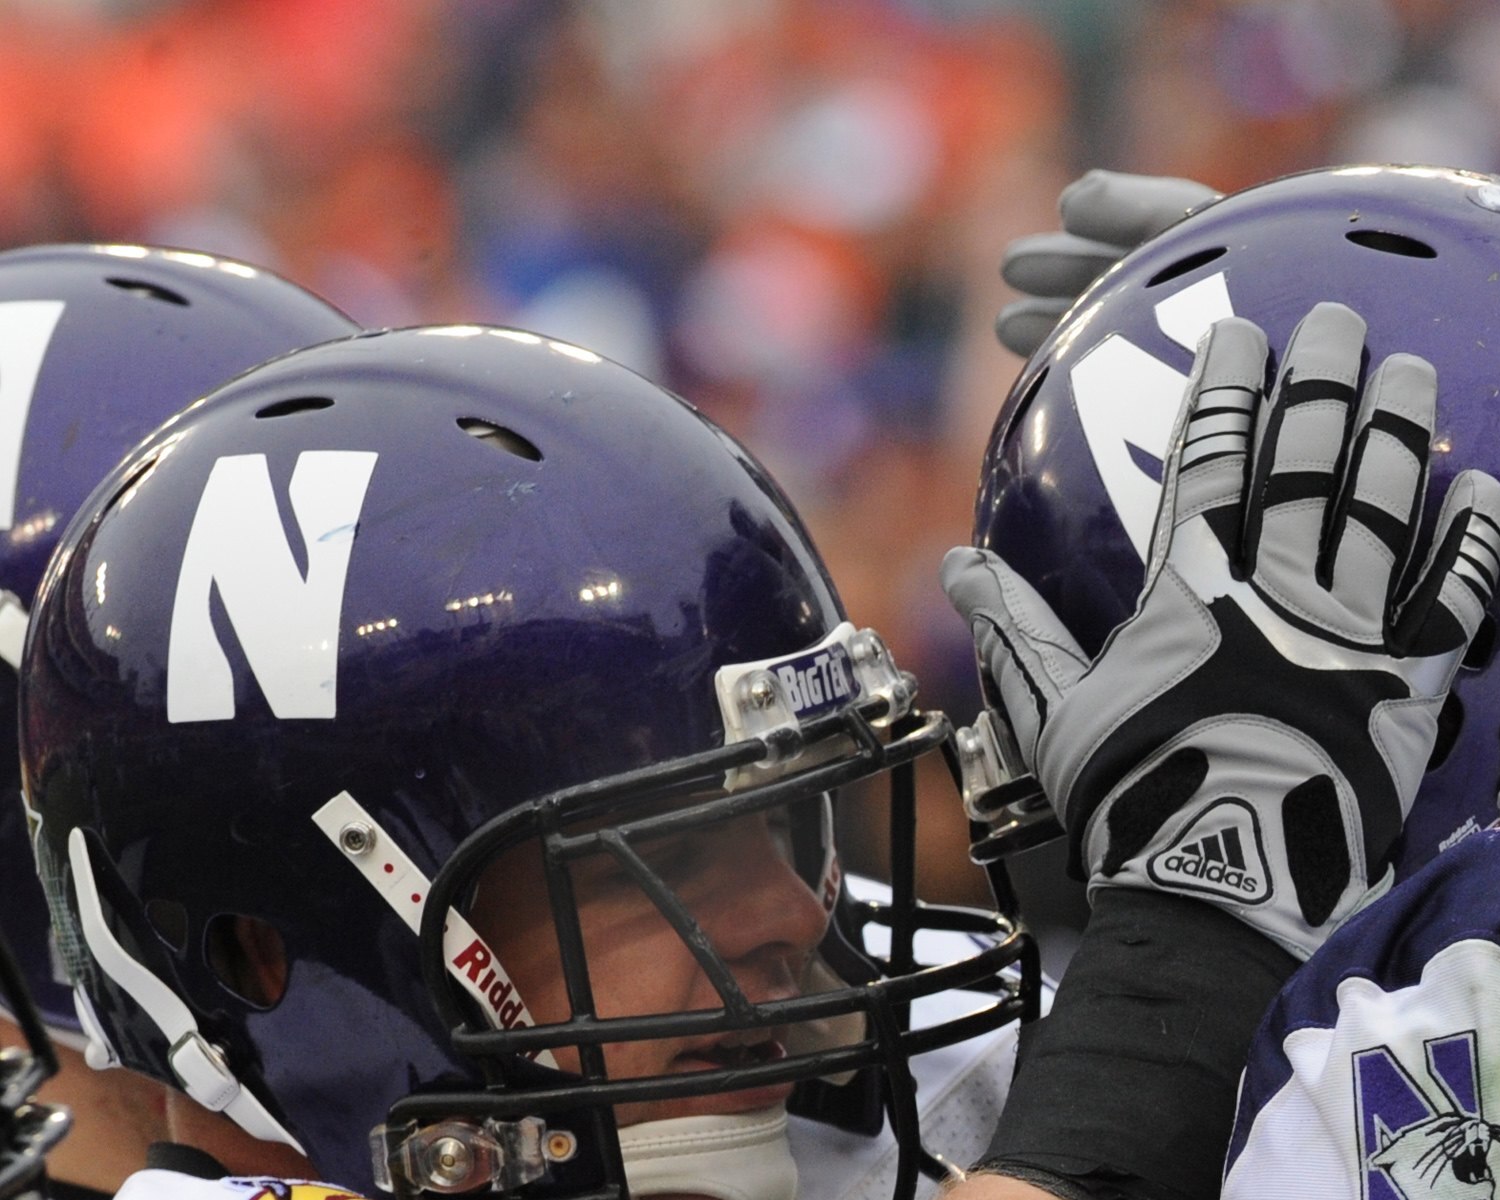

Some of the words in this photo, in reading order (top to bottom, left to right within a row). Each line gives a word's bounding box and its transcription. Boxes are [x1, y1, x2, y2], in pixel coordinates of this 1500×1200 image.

[168, 450, 378, 723] N
[1164, 855, 1258, 893] adidas
[452, 938, 535, 1056] Ridd
